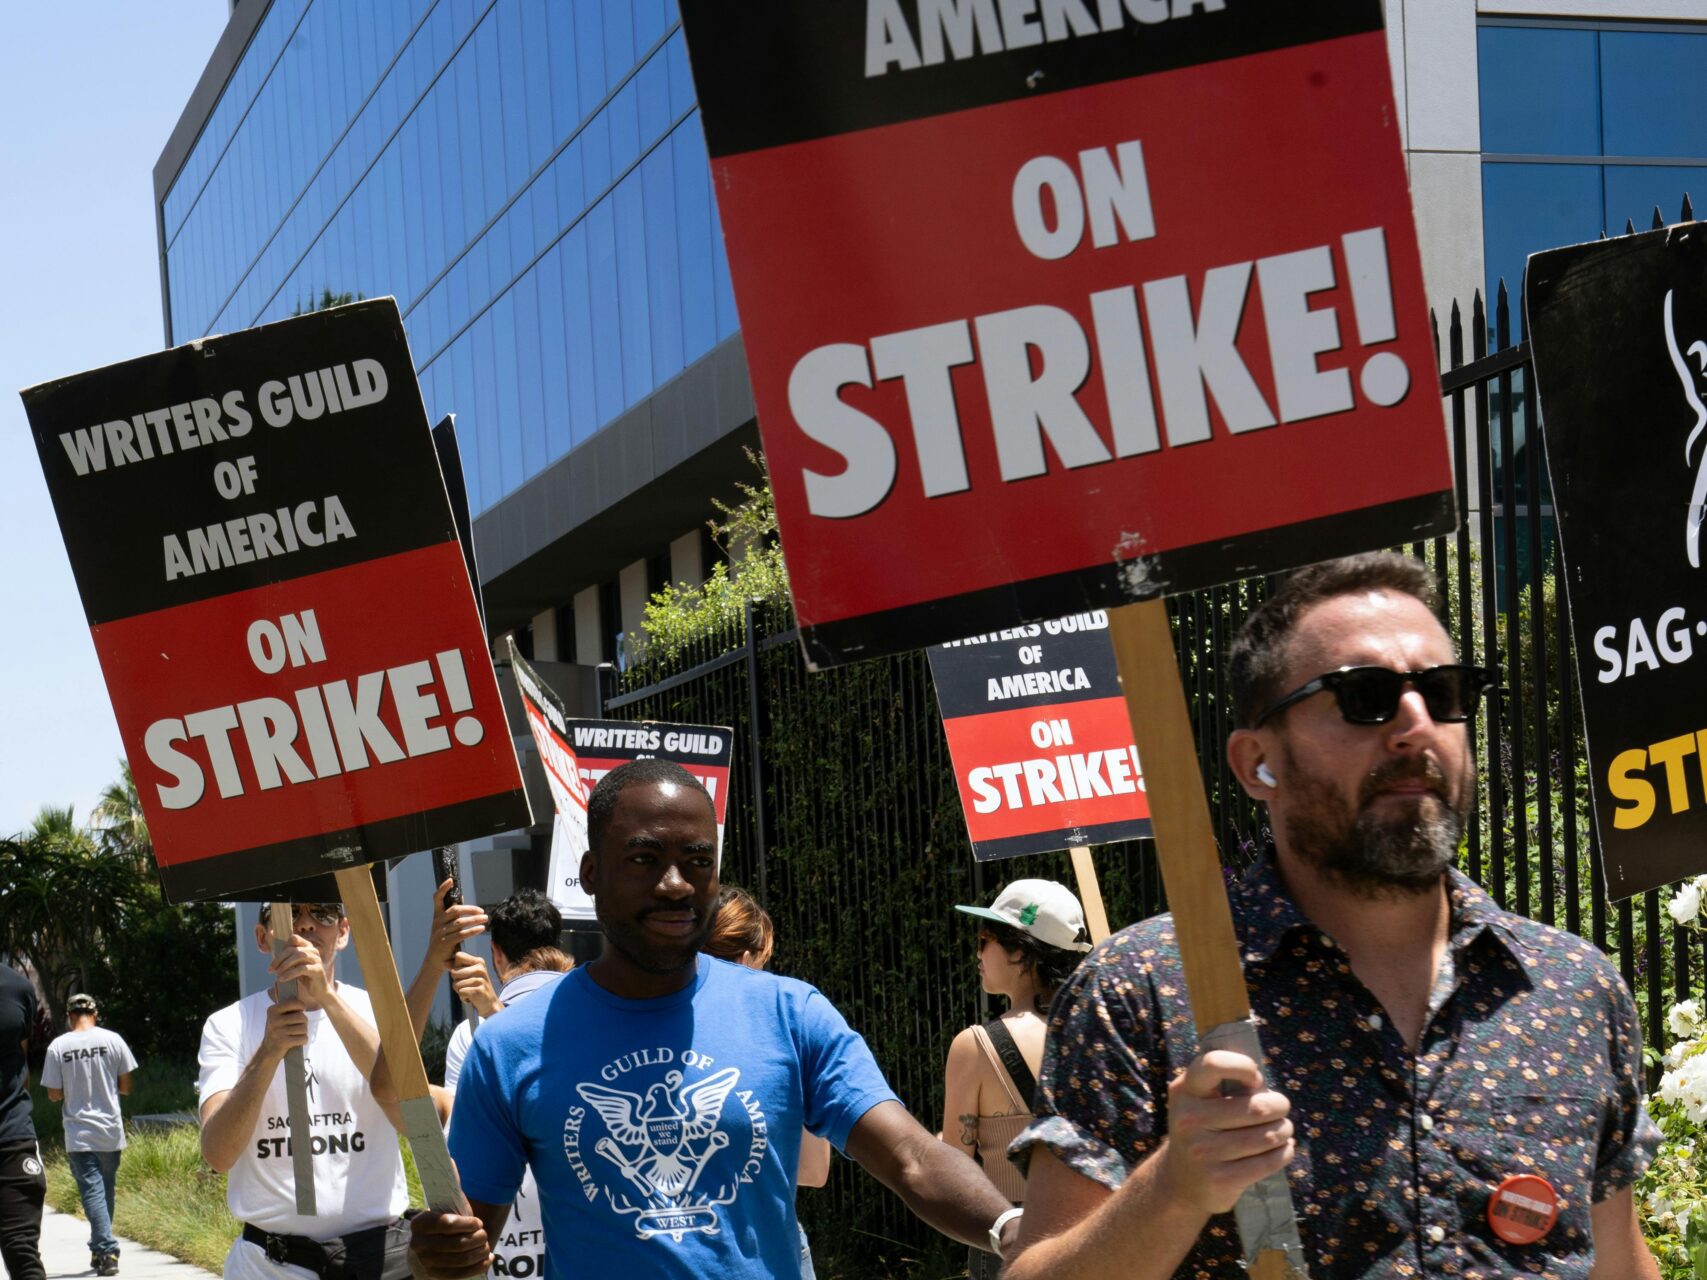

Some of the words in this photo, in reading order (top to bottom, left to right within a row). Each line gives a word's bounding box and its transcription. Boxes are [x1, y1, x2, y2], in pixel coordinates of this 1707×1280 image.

[864, 0, 1226, 78] AMER
[1011, 139, 1157, 260] ON
[787, 226, 1410, 519] STRIKE!
[58, 390, 253, 476] WRITERS
[258, 358, 389, 428] GUILD
[213, 455, 258, 500] OF
[163, 495, 357, 581] AMERICA
[246, 608, 327, 675] ON
[1043, 609, 1109, 636] GUILD
[1018, 645, 1043, 665] OF
[987, 667, 1092, 702] AMERICA
[143, 648, 485, 810] STRIKE!
[574, 727, 661, 751] WRITERS
[663, 731, 723, 755] GUILD
[1030, 718, 1074, 749] ON
[967, 744, 1147, 814] STRIKE!
[1607, 728, 1707, 830] ST
[62, 1046, 109, 1064] STAFF
[563, 1105, 600, 1203] WRITERS
[601, 1047, 674, 1082] GUILD
[680, 1049, 715, 1071] OF
[735, 1089, 768, 1185] AMERICA
[650, 1120, 679, 1132] united
[653, 1135, 678, 1146] stand
[656, 1214, 697, 1229] WEST
